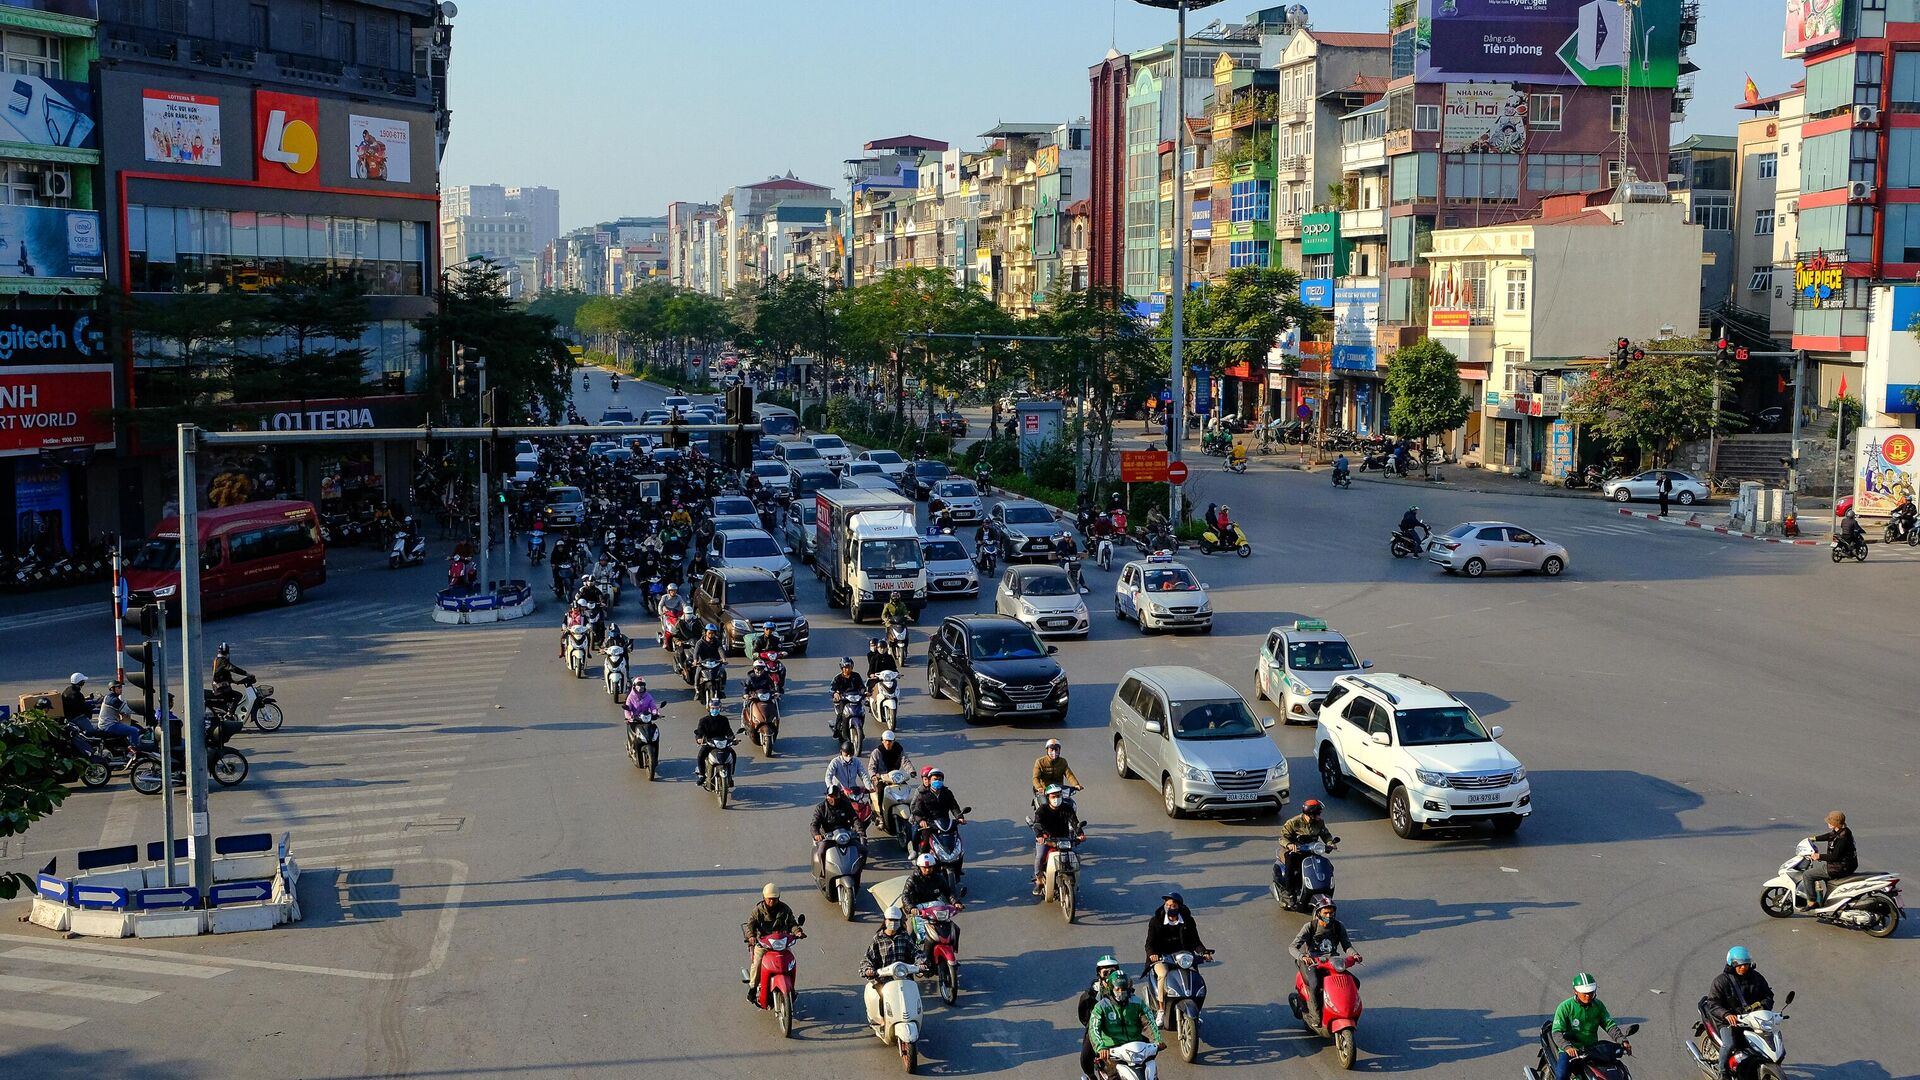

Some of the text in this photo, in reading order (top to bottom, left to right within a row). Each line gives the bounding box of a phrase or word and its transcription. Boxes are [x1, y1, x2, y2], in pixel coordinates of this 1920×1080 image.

[1484, 44, 1543, 56] Tiên phong
[1796, 268, 1842, 291] ONE PIECE
[20, 412, 77, 429] WORLD
